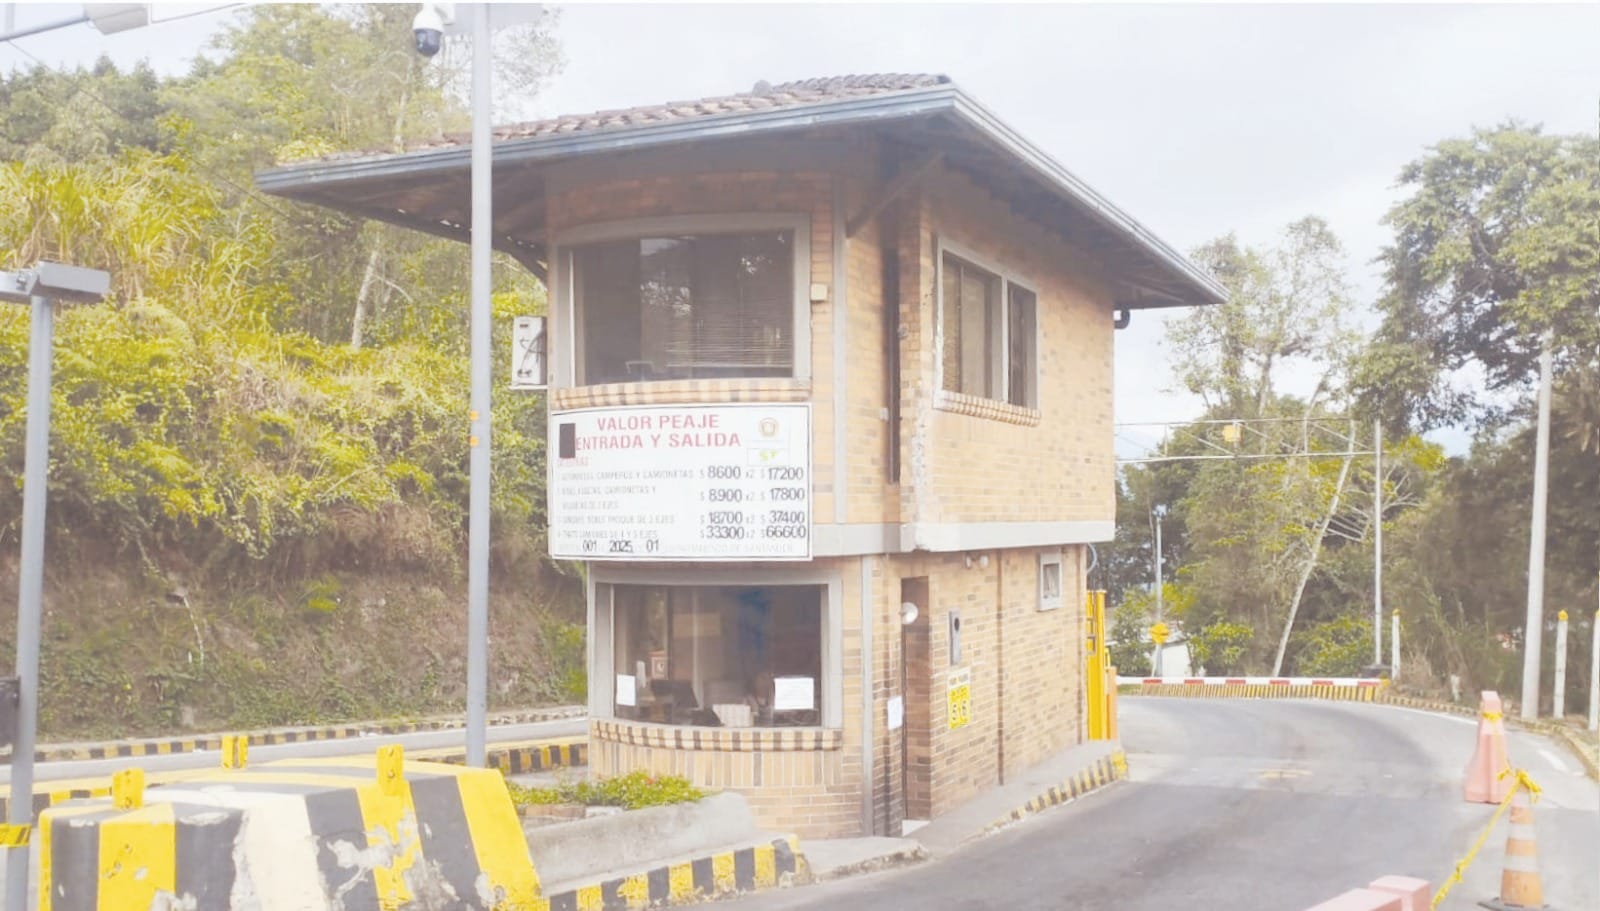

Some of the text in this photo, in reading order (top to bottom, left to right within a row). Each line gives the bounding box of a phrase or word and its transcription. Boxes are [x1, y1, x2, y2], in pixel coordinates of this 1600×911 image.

[597, 414, 720, 431] VALOR PEAJE
[575, 432, 741, 450] ENTRADA Y SALIDA
[707, 465, 741, 480] 8600
[767, 466, 804, 481] 17200
[769, 487, 805, 502] 17800
[709, 511, 743, 525] 18700
[769, 510, 805, 525] 37400
[706, 525, 745, 540] 33300
[766, 525, 807, 539] 66600
[646, 539, 660, 552] 01
